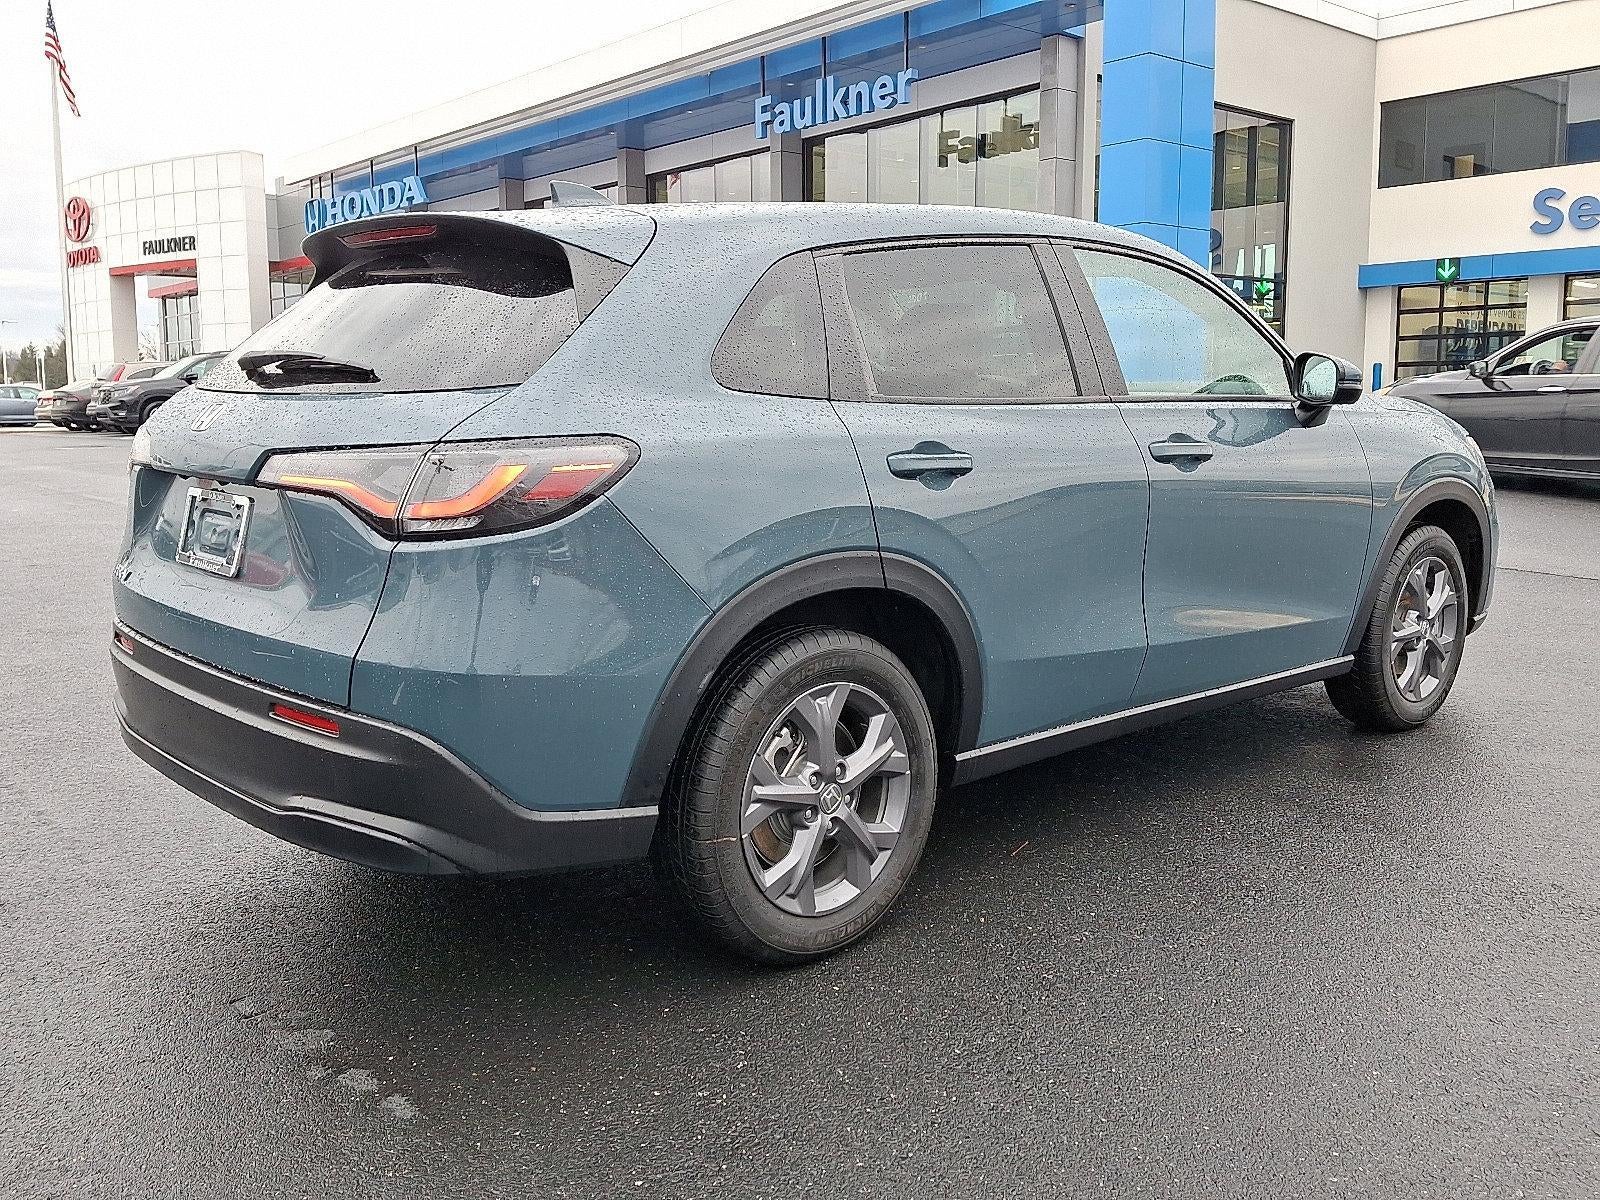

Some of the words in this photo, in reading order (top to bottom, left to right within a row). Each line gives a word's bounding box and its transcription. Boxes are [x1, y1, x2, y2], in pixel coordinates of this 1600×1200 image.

[754, 67, 919, 139] Faulkner
[324, 175, 429, 227] HONDA
[67, 245, 100, 268] OYOTA
[142, 235, 197, 257] FAULKNER
